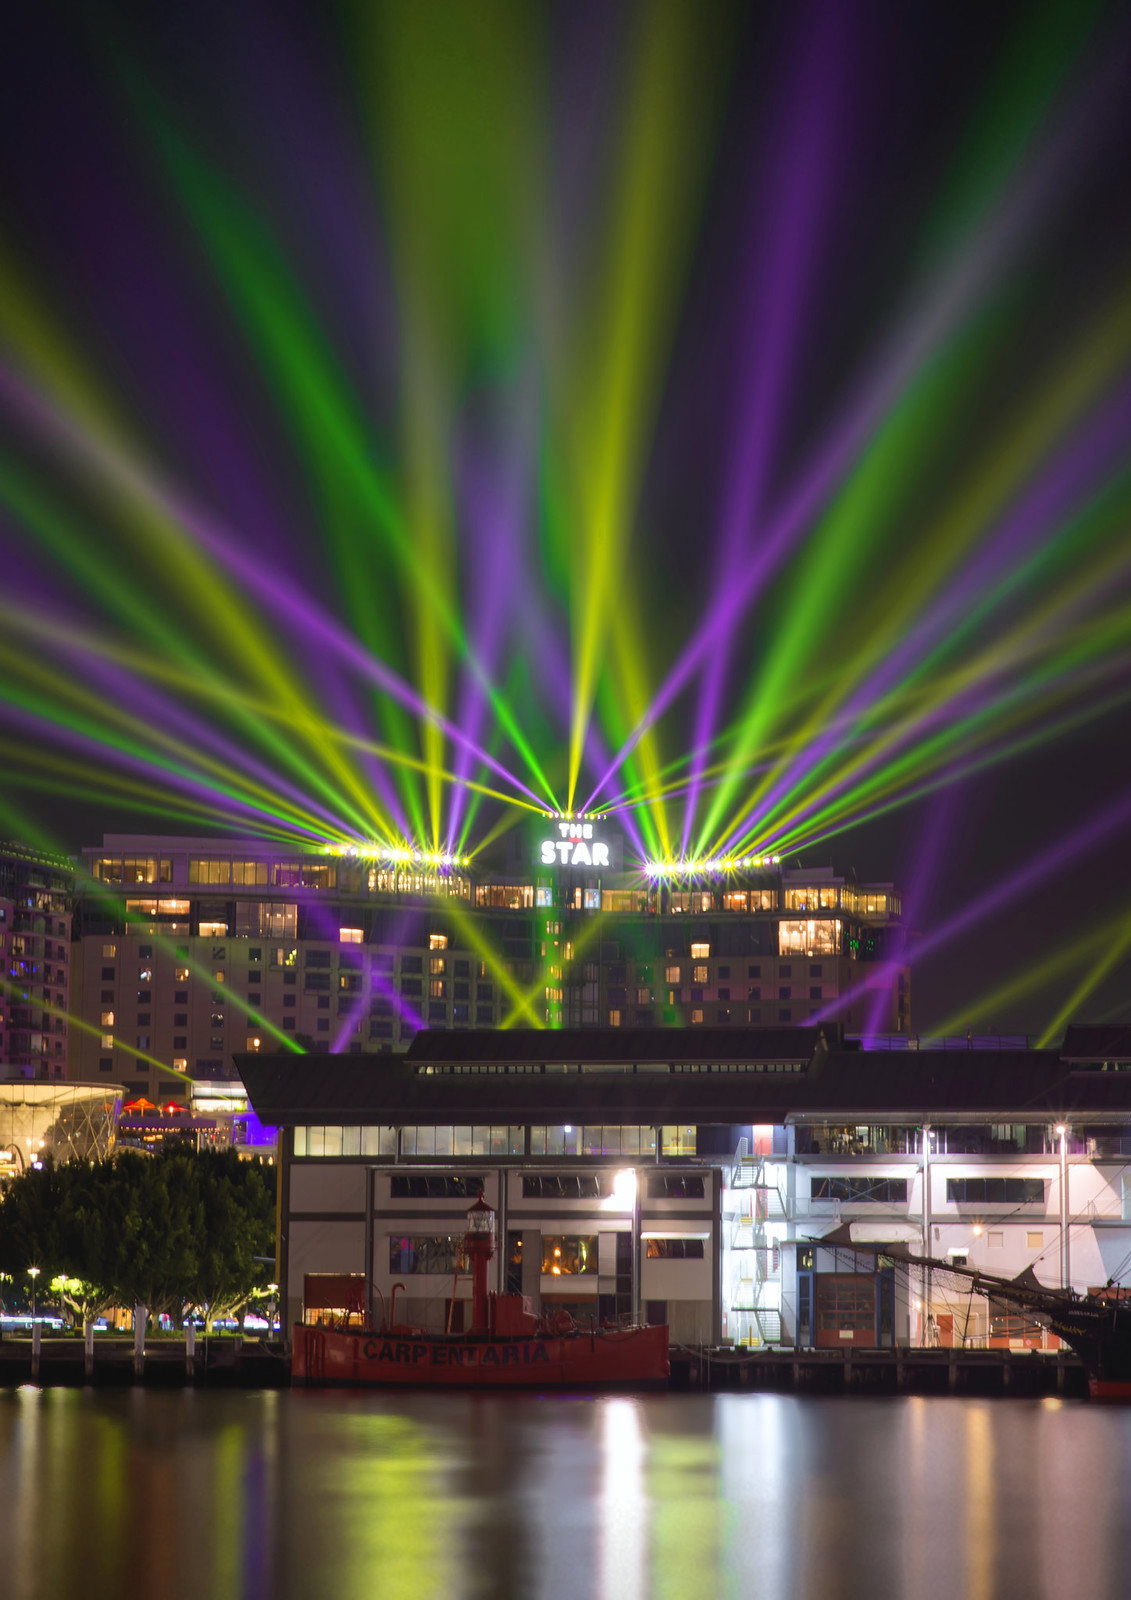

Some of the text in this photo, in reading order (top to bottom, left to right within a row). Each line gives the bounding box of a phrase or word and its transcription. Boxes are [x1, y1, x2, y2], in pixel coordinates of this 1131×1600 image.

[559, 823, 593, 839] THE
[541, 841, 609, 866] STAR
[363, 1340, 550, 1366] CARPENTARIA
